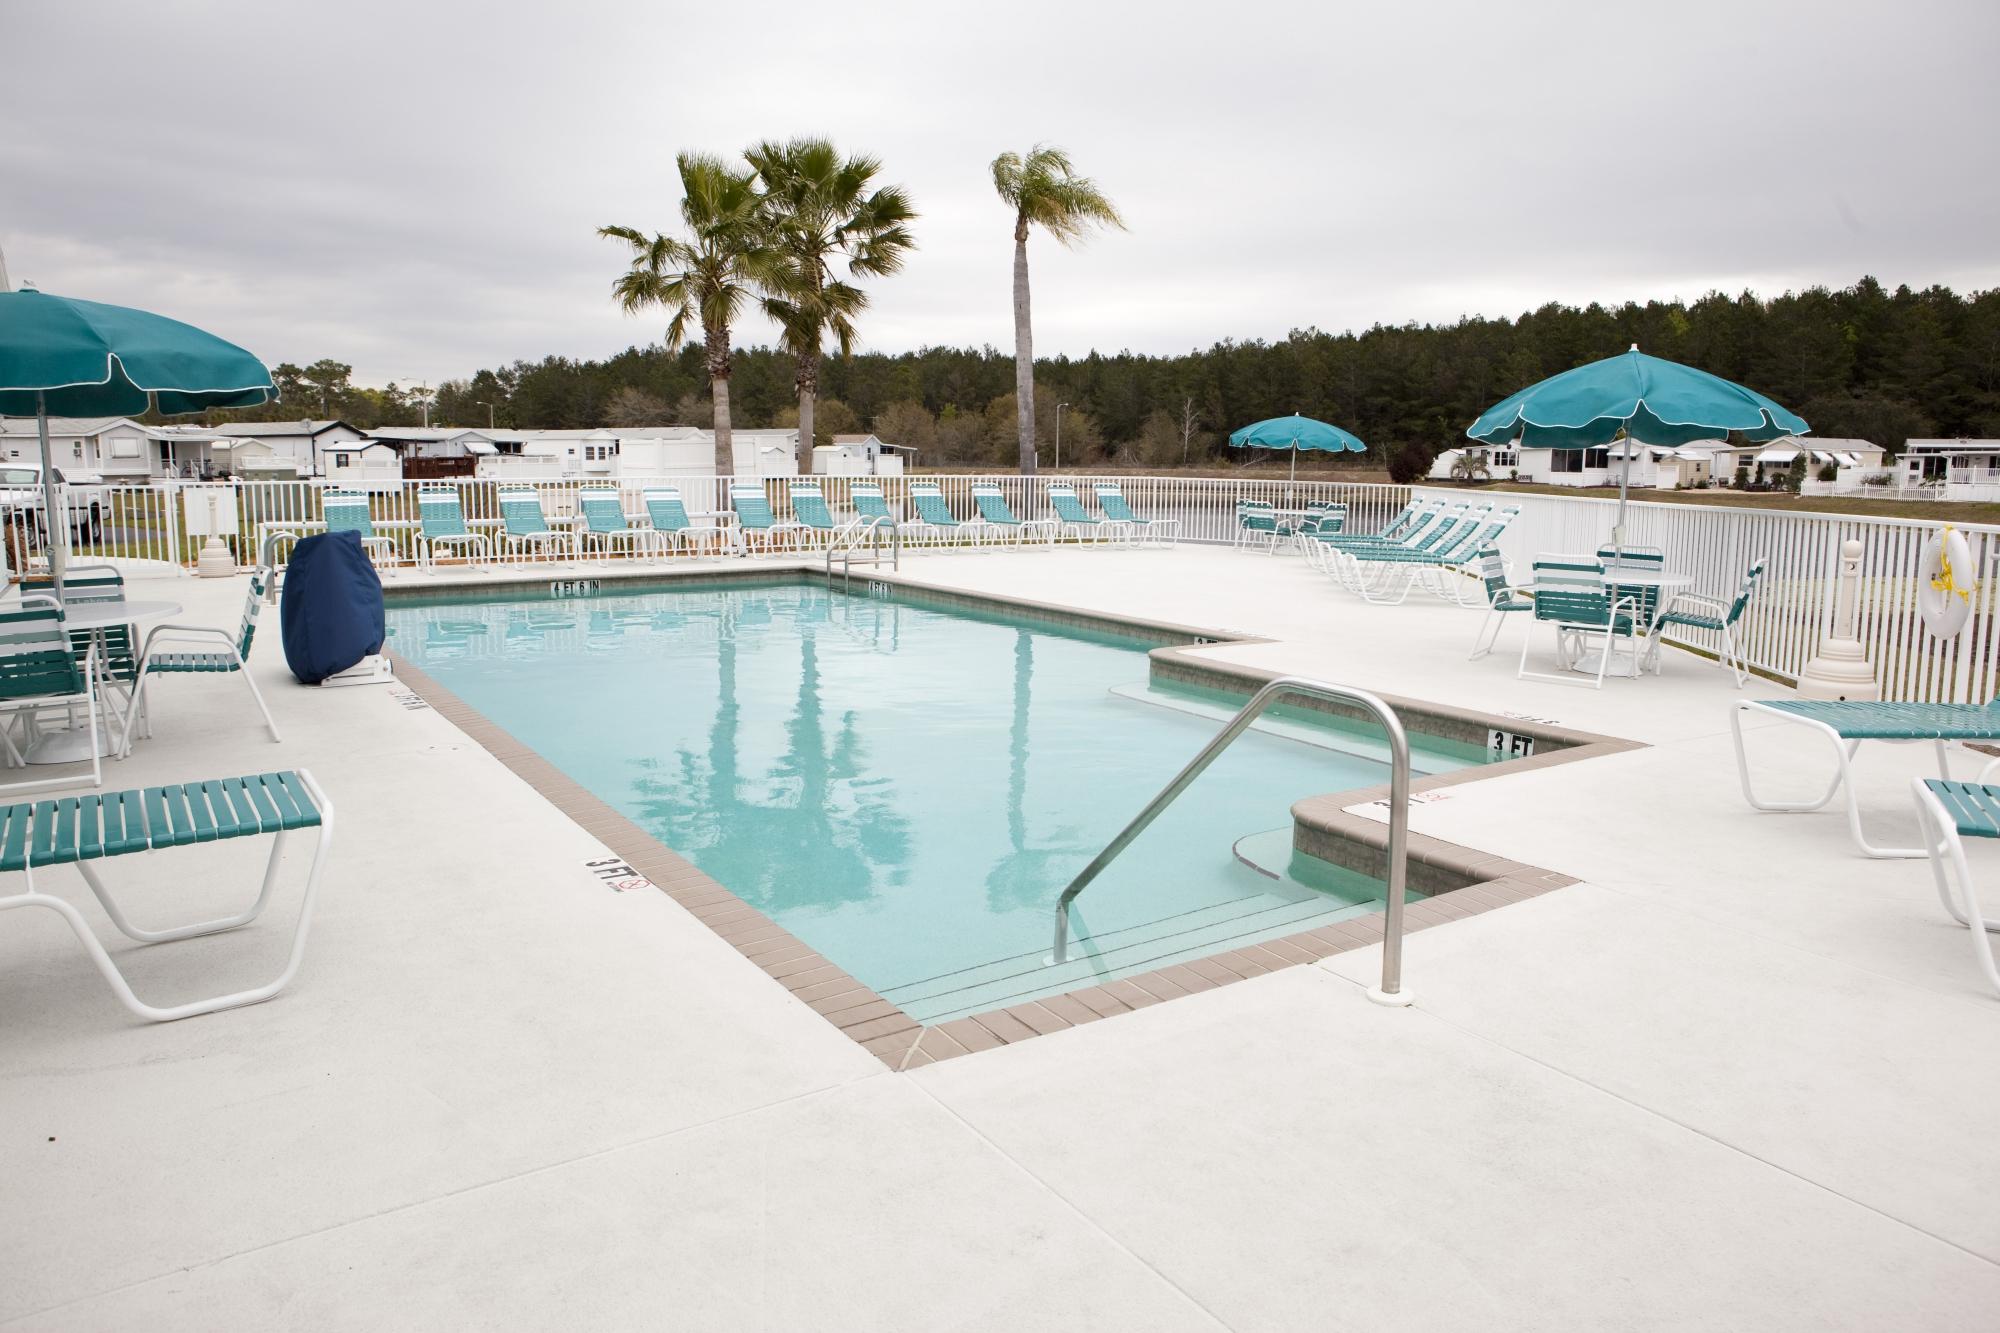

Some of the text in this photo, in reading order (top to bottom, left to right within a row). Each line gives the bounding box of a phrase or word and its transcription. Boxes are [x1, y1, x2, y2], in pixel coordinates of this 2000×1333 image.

[1493, 731, 1533, 757] 3 FT
[585, 858, 639, 880] 3 FT
